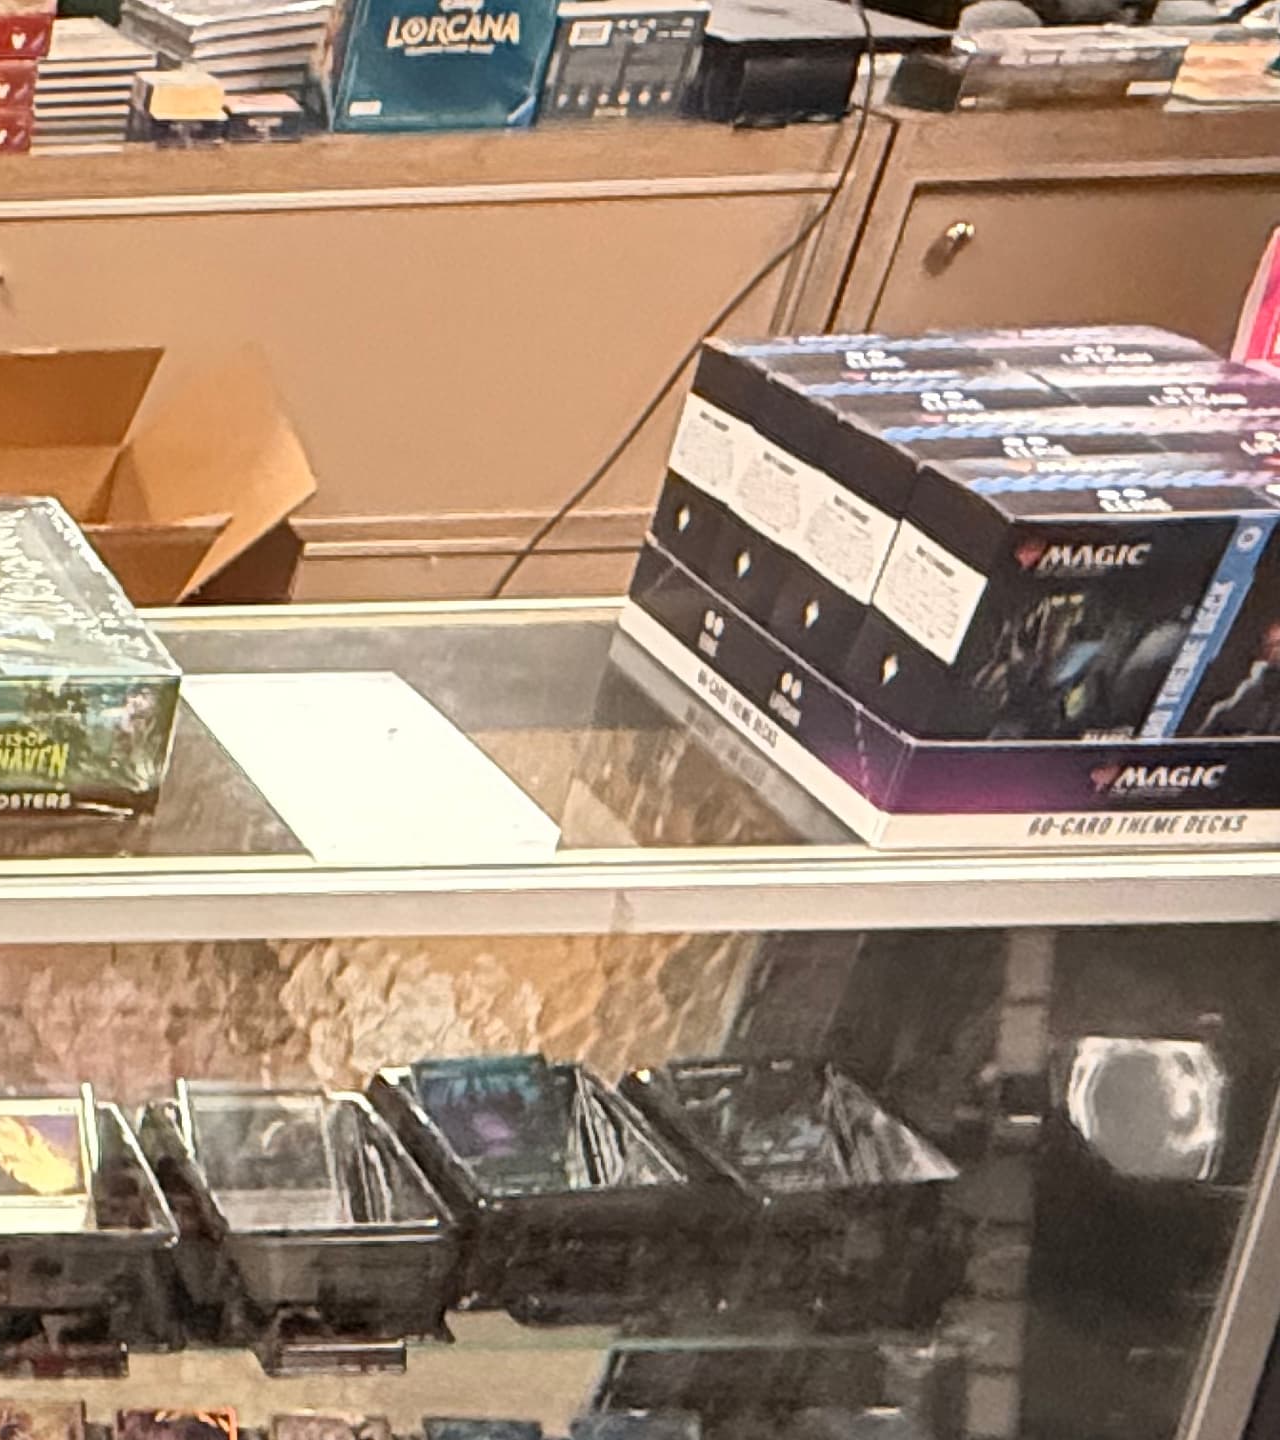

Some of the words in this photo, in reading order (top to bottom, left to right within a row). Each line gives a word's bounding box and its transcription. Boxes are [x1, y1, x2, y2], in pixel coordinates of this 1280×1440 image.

[387, 11, 521, 48] LORCANA
[1038, 543, 1152, 570] MAGIC
[1113, 764, 1228, 789] MAGIC
[1027, 816, 1113, 837] 60-CARD
[1117, 815, 1182, 836] THEME
[1184, 814, 1248, 834] DECKS
